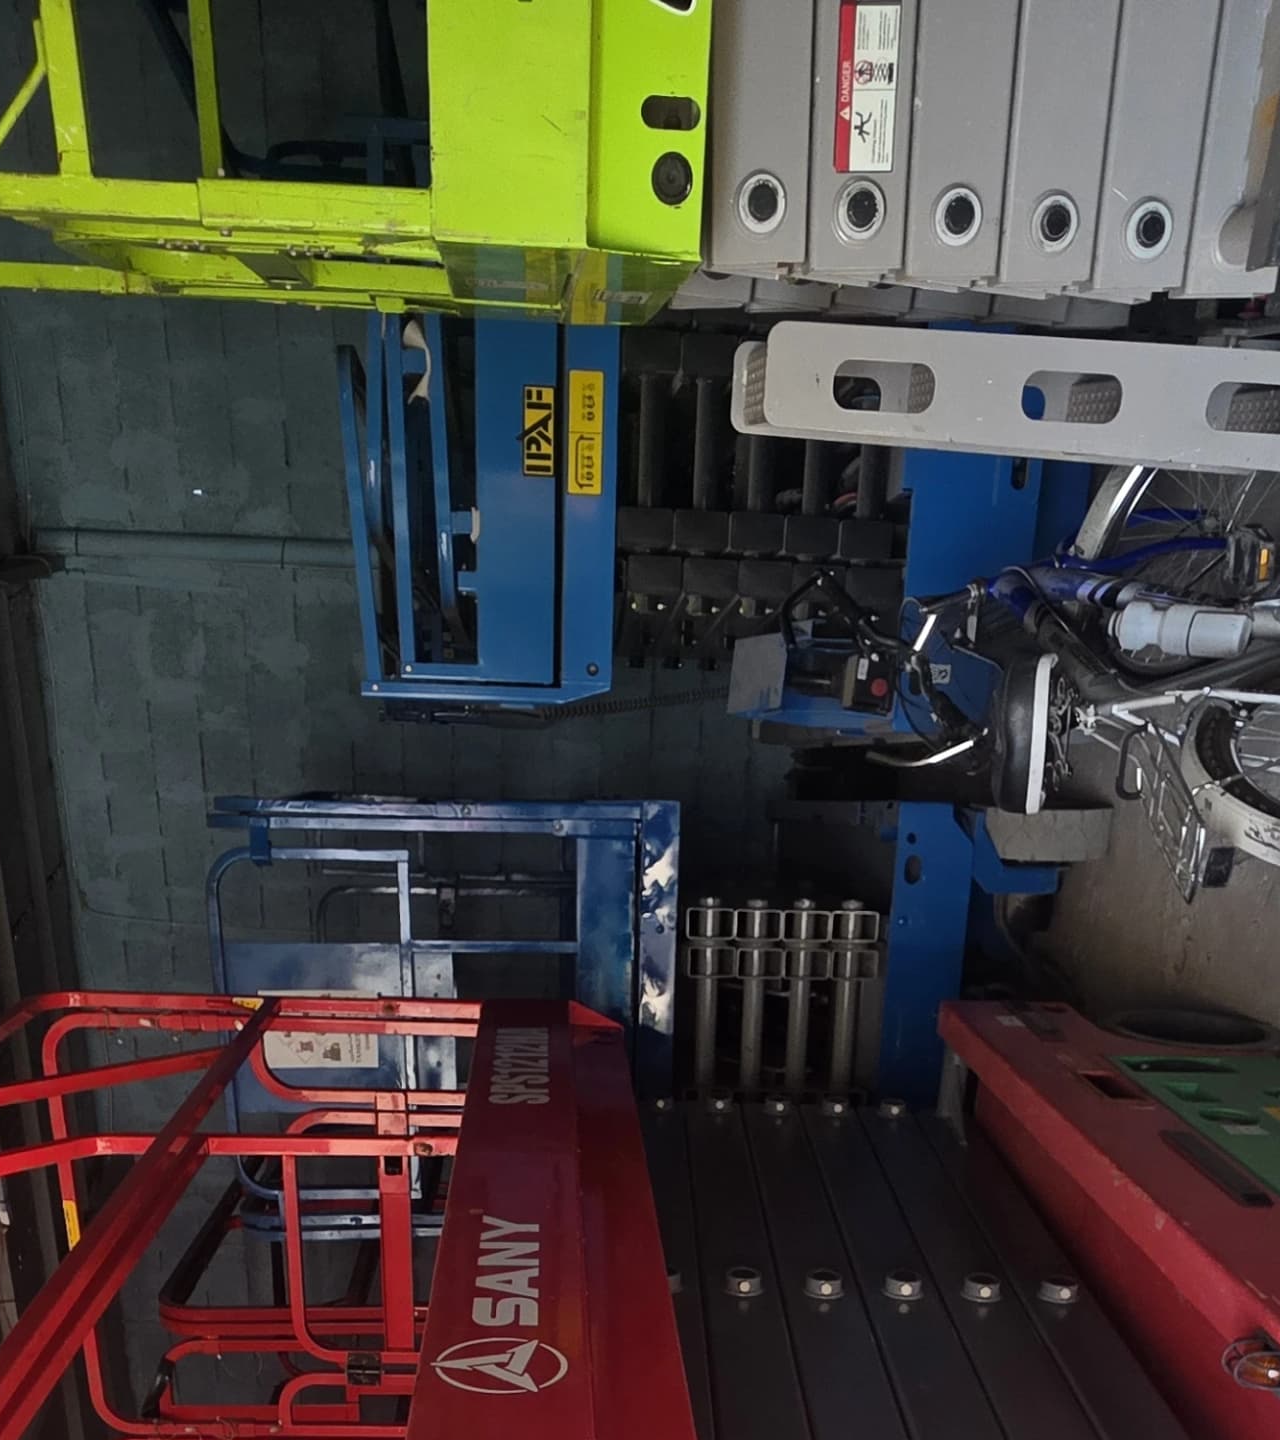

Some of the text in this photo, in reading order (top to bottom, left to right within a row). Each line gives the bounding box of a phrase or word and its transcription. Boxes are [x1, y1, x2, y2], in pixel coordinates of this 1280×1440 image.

[840, 60, 851, 103] DANGER
[516, 388, 553, 474] IPAF
[471, 1214, 540, 1327] SANY
